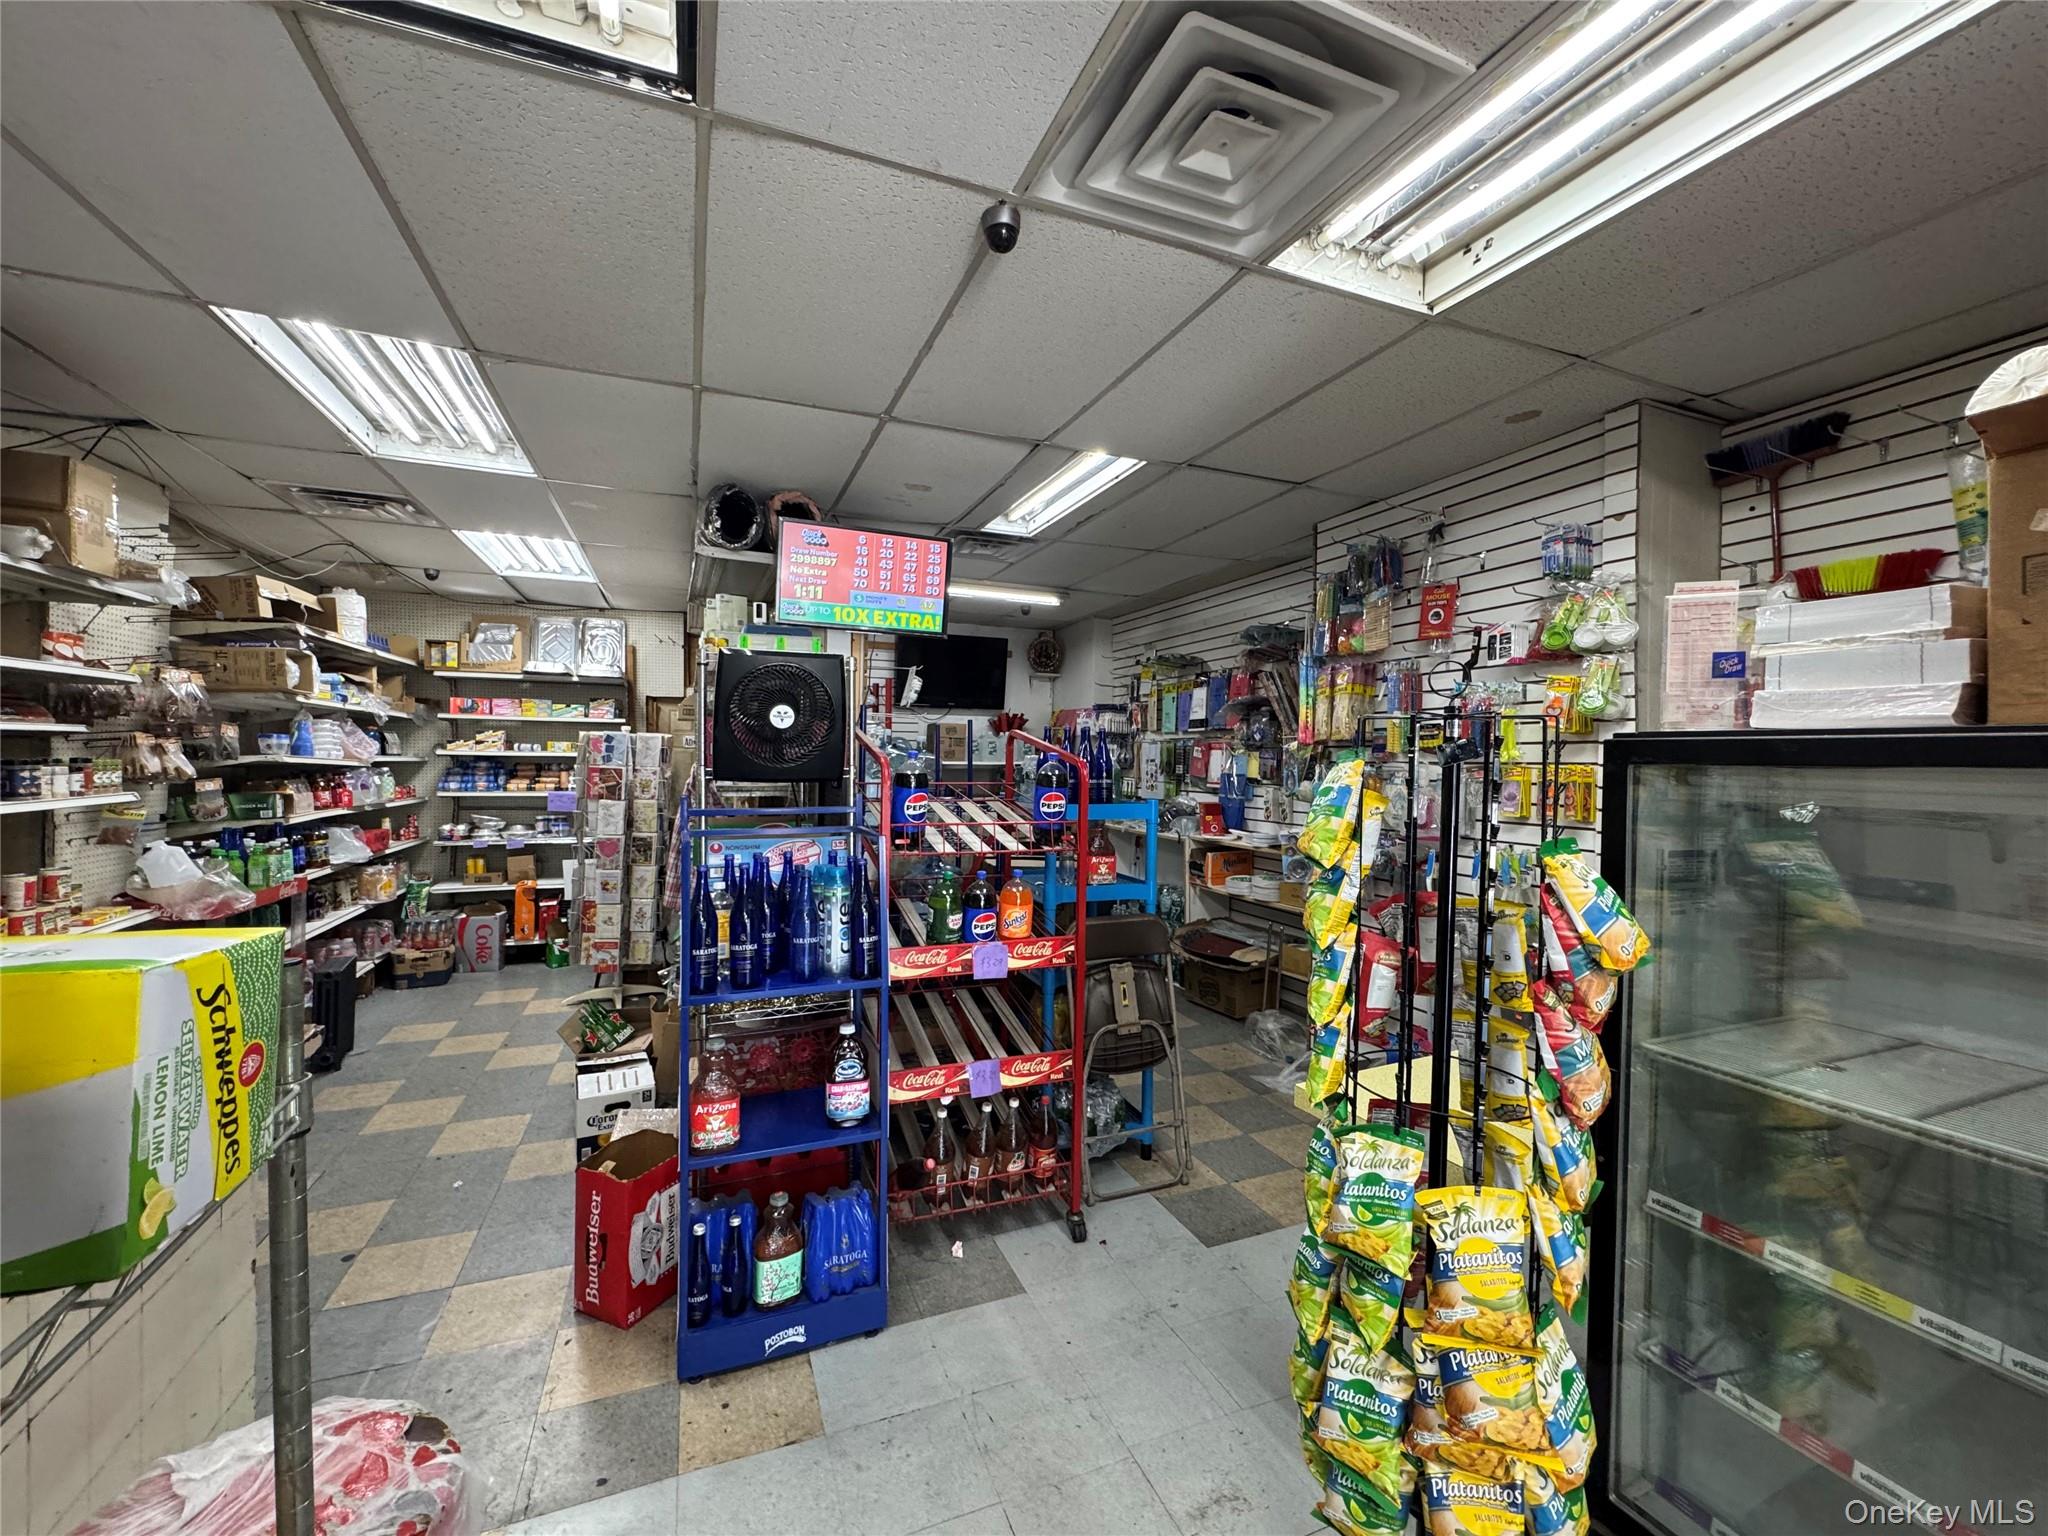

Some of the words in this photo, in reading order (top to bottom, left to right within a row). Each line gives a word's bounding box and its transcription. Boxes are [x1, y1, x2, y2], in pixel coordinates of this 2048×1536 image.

[859, 535, 867, 545] 6
[881, 538, 894, 548] 12
[905, 541, 918, 550] 14
[929, 543, 942, 553] 15
[855, 557, 868, 567] 41
[879, 560, 893, 569] 43
[903, 562, 917, 572] 47
[880, 549, 894, 558] 20
[904, 552, 918, 561] 22
[928, 555, 941, 564] 25
[789, 565, 803, 575] No
[804, 567, 827, 577] Extra
[853, 568, 868, 578] 50
[880, 571, 892, 580] 51
[902, 574, 917, 583] 65
[793, 584, 823, 600] 1:11
[853, 579, 868, 588] 70
[880, 582, 891, 591] 71
[902, 584, 916, 594] 74
[804, 606, 817, 615] UP
[819, 606, 831, 615] TO
[833, 606, 868, 624] 10X
[873, 609, 941, 631] EXTRA!
[1719, 657, 1739, 669] Quick
[1724, 664, 1742, 675] Draw
[725, 843, 761, 851] NONGSHIM
[1003, 911, 1028, 929] Sunkist
[474, 923, 493, 964] Coke
[178, 1018, 194, 1104] SELTZER
[197, 981, 242, 1175] Schweppes
[1050, 1072, 1064, 1080] Real
[153, 1055, 169, 1121] LEMON
[945, 1085, 960, 1094] Real
[695, 1102, 737, 1116] AriZona
[587, 1113, 618, 1128] Coron
[151, 1126, 166, 1167] LIME
[173, 1104, 193, 1183] WATER
[1340, 1147, 1410, 1171] Soldanza
[664, 1192, 677, 1265] Budweiser
[585, 1190, 602, 1305] Budweiser
[823, 1250, 868, 1270] SARATOGA
[1438, 1246, 1523, 1271] Platanitos
[764, 1324, 806, 1351] POSTOBON
[1325, 1381, 1398, 1417] Platanitos
[1431, 1477, 1522, 1504] Platanitos
